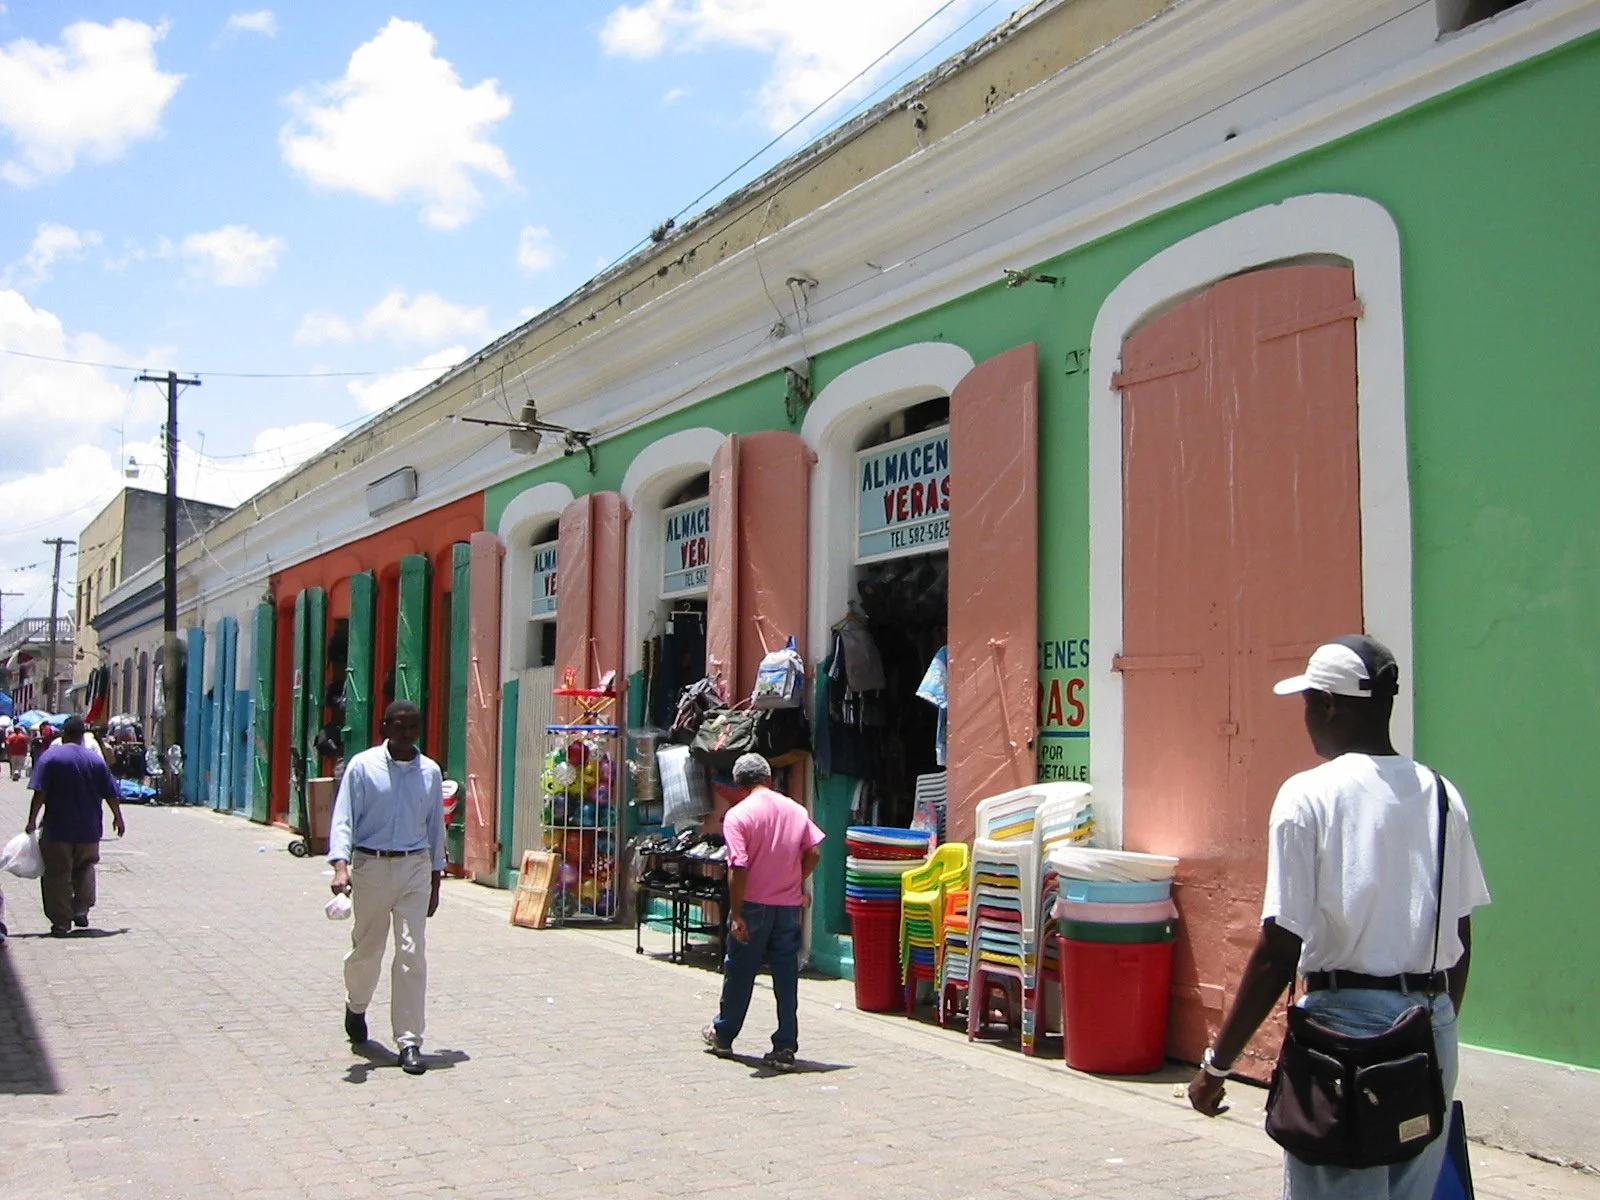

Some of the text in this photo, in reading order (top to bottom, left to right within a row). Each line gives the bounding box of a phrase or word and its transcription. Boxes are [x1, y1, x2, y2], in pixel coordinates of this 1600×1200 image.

[862, 438, 948, 492] ALMACEN
[883, 474, 950, 525] VERAS
[681, 537, 710, 569] VER
[1037, 638, 1090, 670] ENES
[1041, 745, 1063, 760] POR
